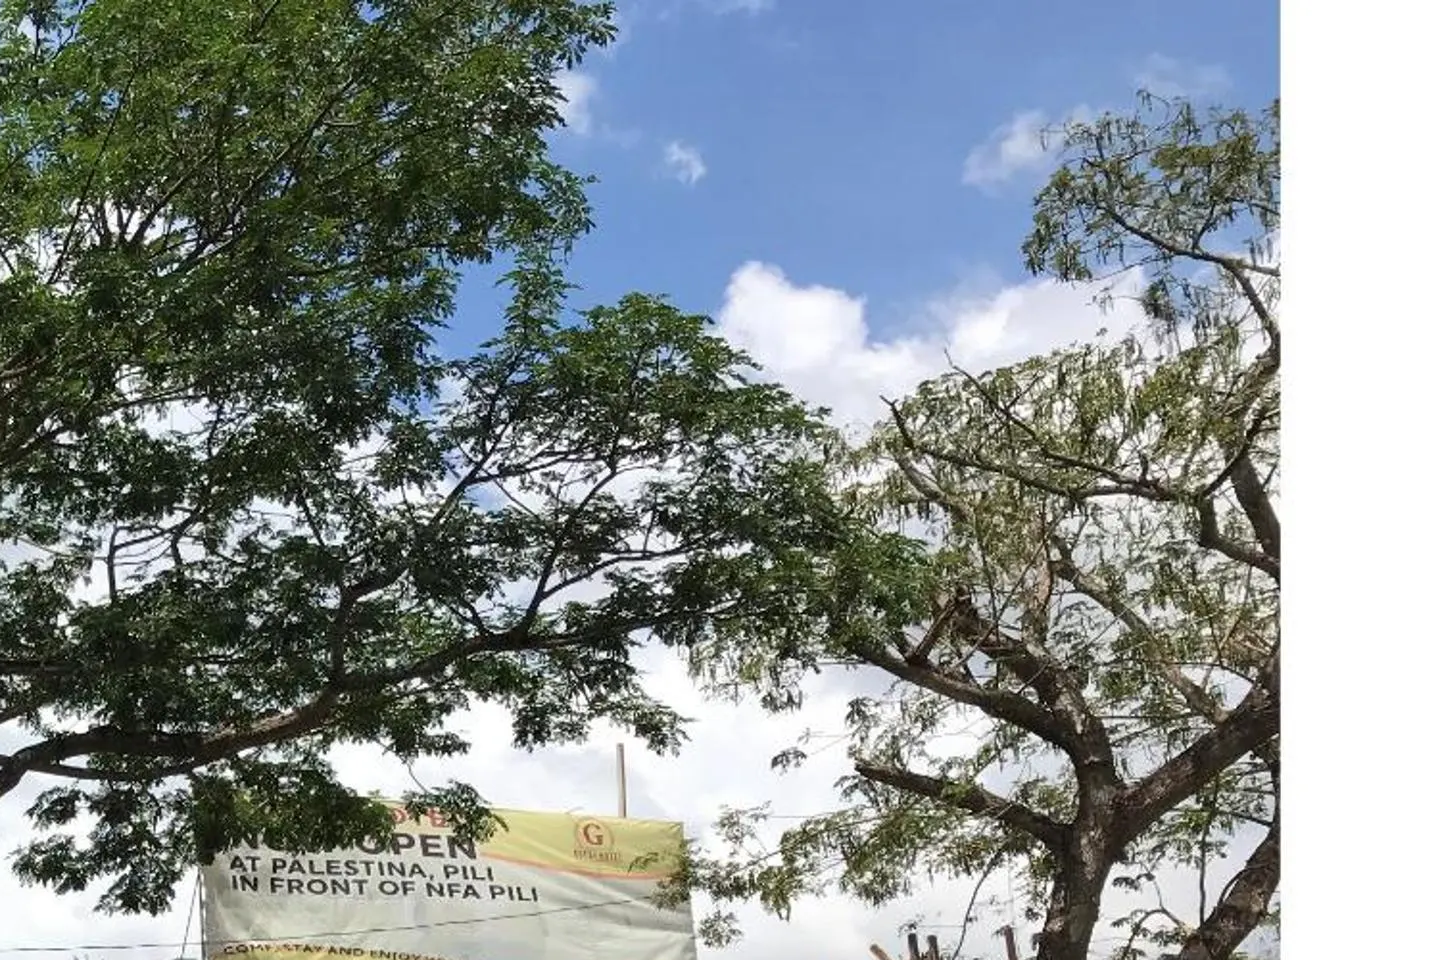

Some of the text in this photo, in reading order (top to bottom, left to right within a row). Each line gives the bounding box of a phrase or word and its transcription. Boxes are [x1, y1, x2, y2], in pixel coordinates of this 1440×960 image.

[358, 832, 478, 860] OPEN
[230, 855, 495, 882] AT PALESTINA, PILI
[232, 875, 539, 902] IN FRONT OF NFA PILI
[283, 943, 324, 954] STAY
[328, 946, 365, 958] AND
